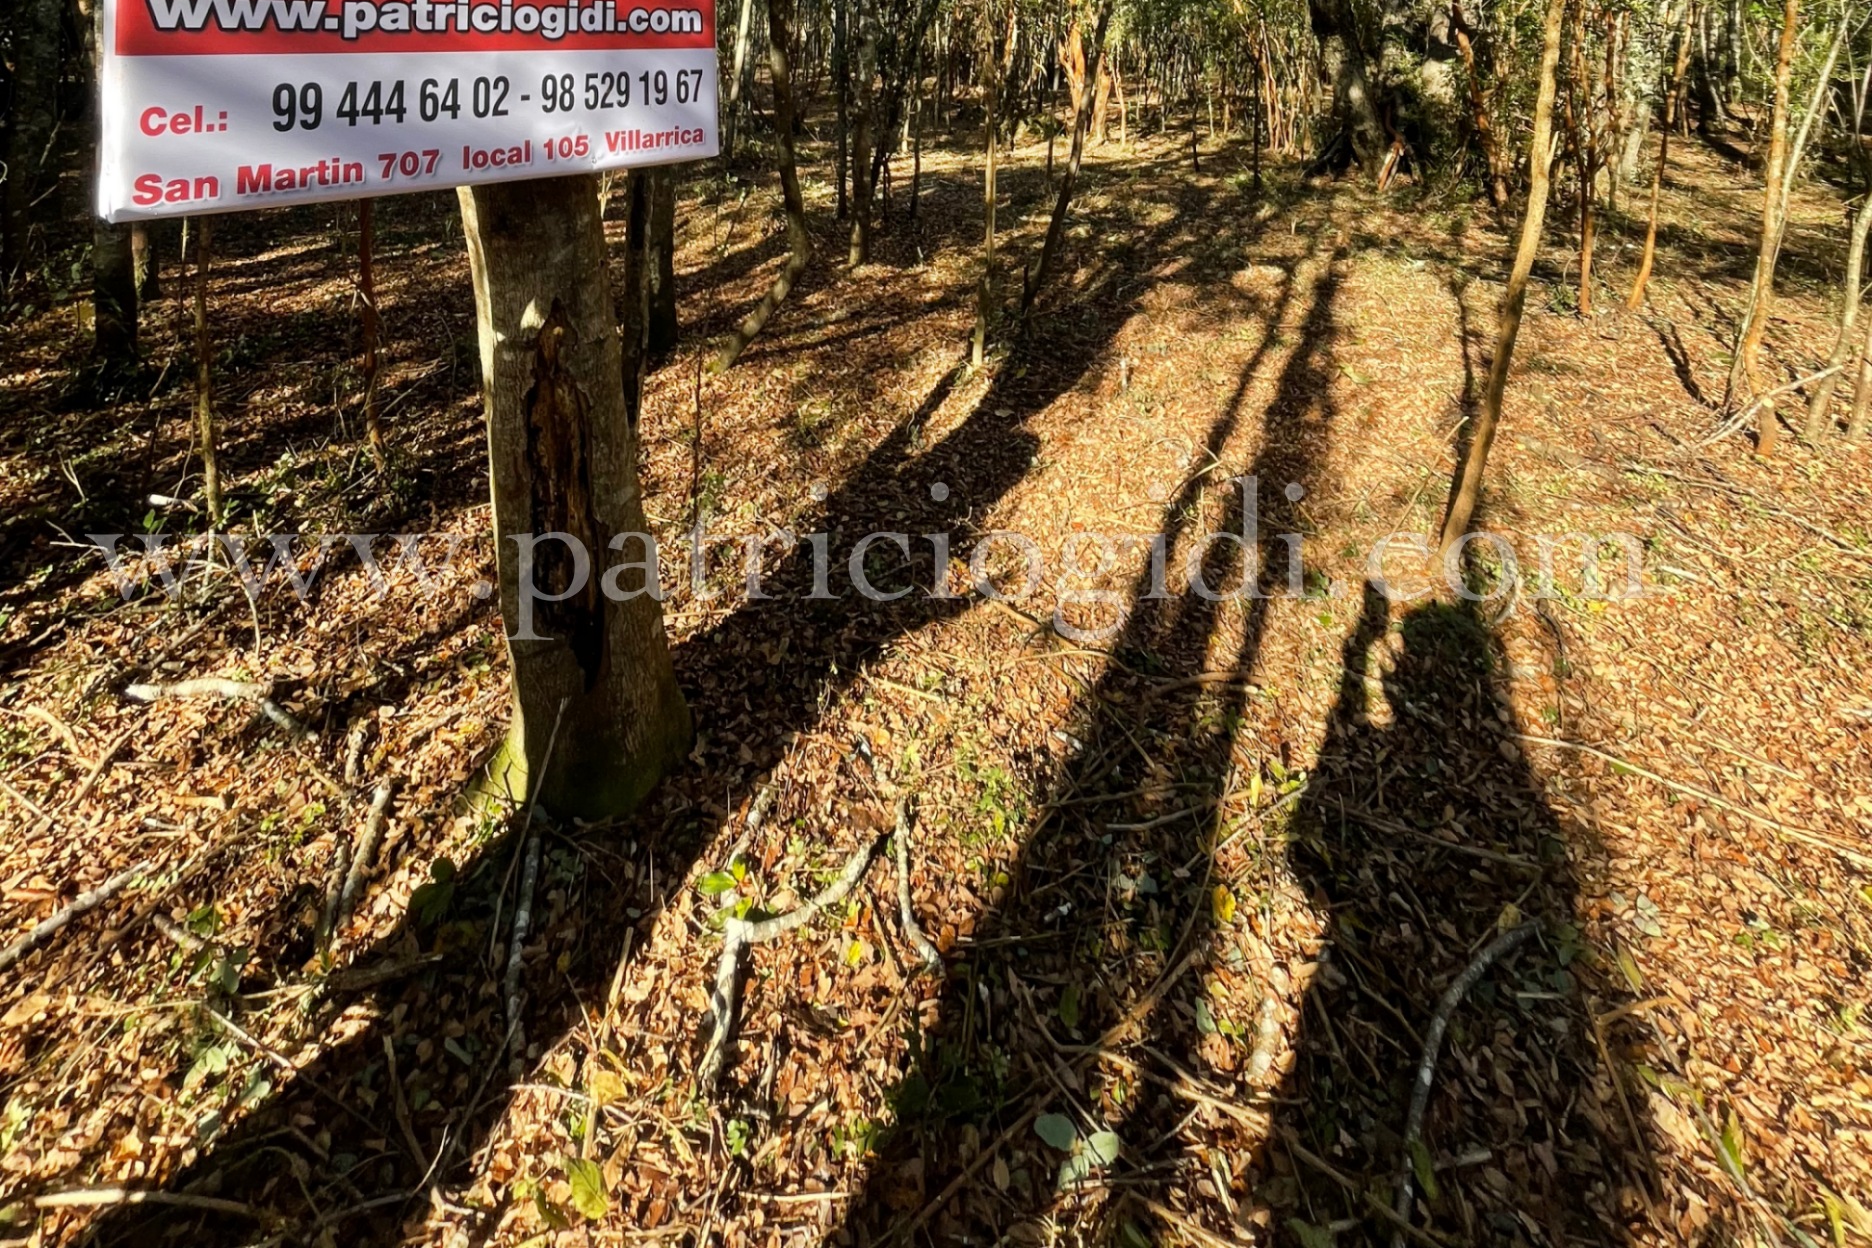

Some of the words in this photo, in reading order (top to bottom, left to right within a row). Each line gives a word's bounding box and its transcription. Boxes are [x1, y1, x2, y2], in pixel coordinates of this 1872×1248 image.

[140, 105, 228, 137] Cel.:
[271, 82, 323, 133] 99
[336, 79, 407, 127] 444
[419, 77, 461, 123] 64
[472, 75, 510, 119] 02
[541, 73, 575, 113] 98
[584, 71, 631, 111] 529
[638, 69, 668, 106] 19
[675, 68, 704, 104] 67
[132, 173, 219, 207] San
[236, 157, 364, 196] Martin
[377, 148, 440, 180] 707
[461, 139, 531, 171] local
[543, 134, 590, 161] 105
[604, 124, 705, 153] Villarrica
